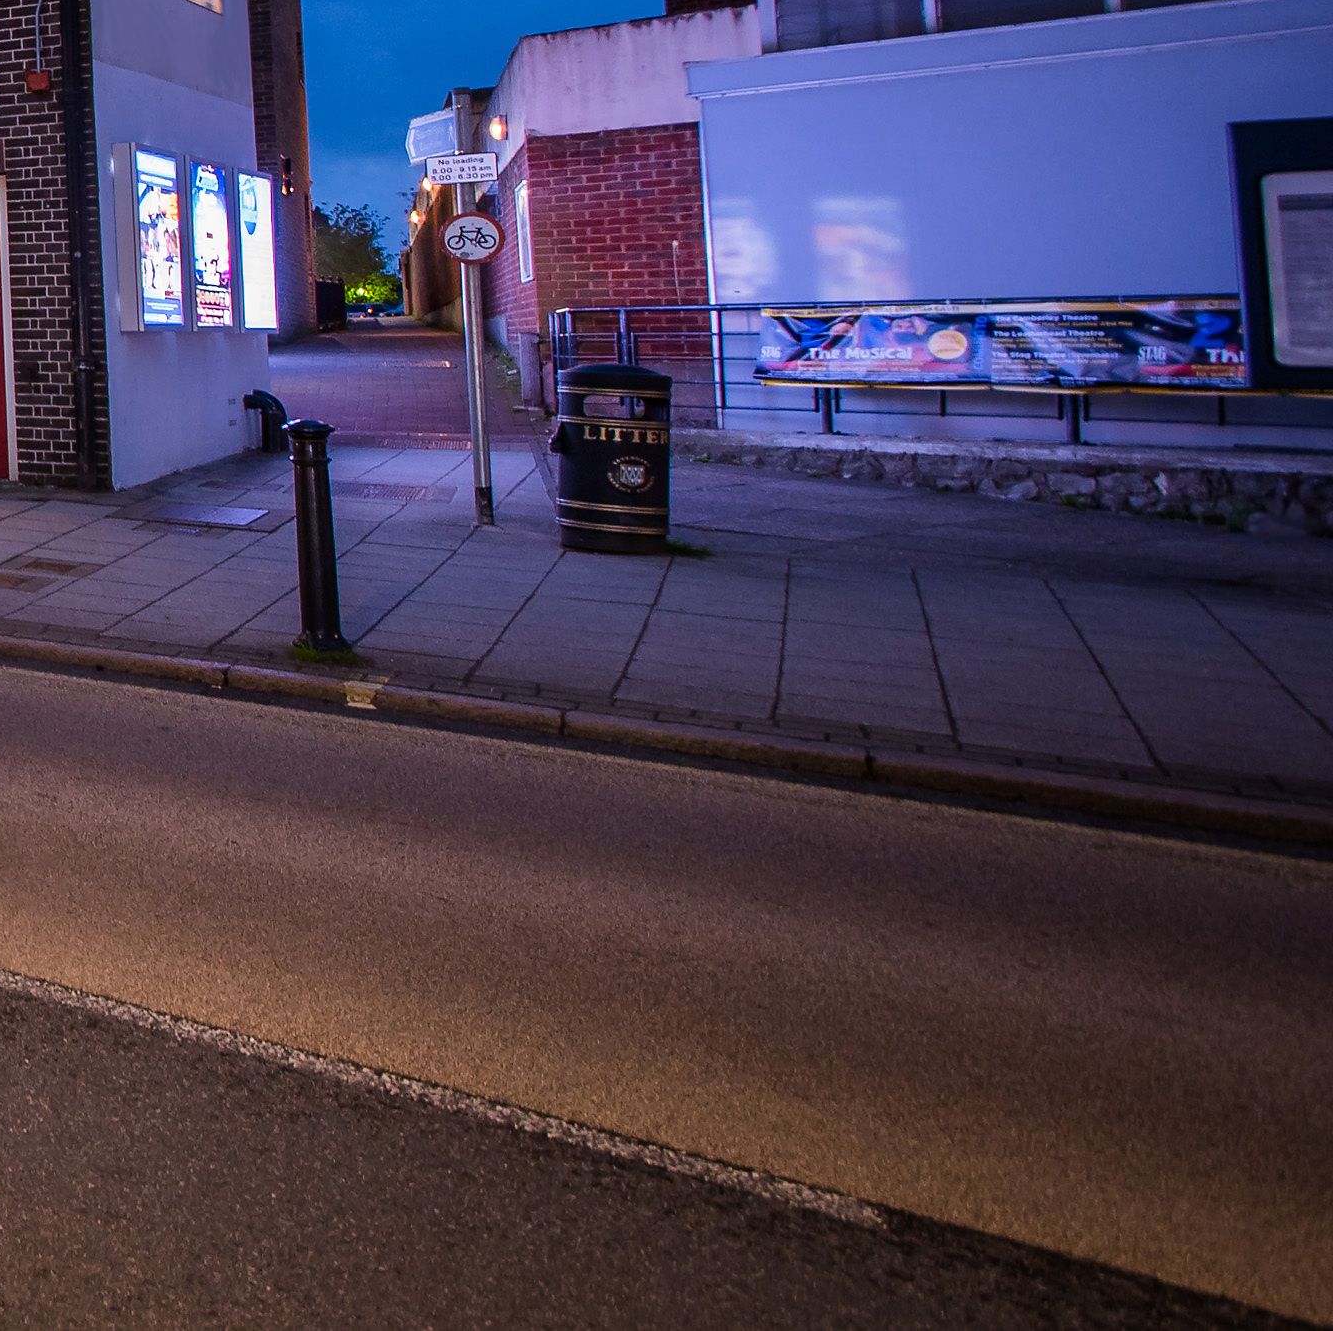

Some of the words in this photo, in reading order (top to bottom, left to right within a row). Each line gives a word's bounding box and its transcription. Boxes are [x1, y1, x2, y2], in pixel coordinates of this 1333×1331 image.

[453, 156, 484, 165] loading
[761, 345, 781, 359] STAG
[809, 347, 841, 360] The
[844, 346, 913, 360] Musical
[1137, 346, 1166, 360] STAG
[583, 425, 669, 445] LITTER
